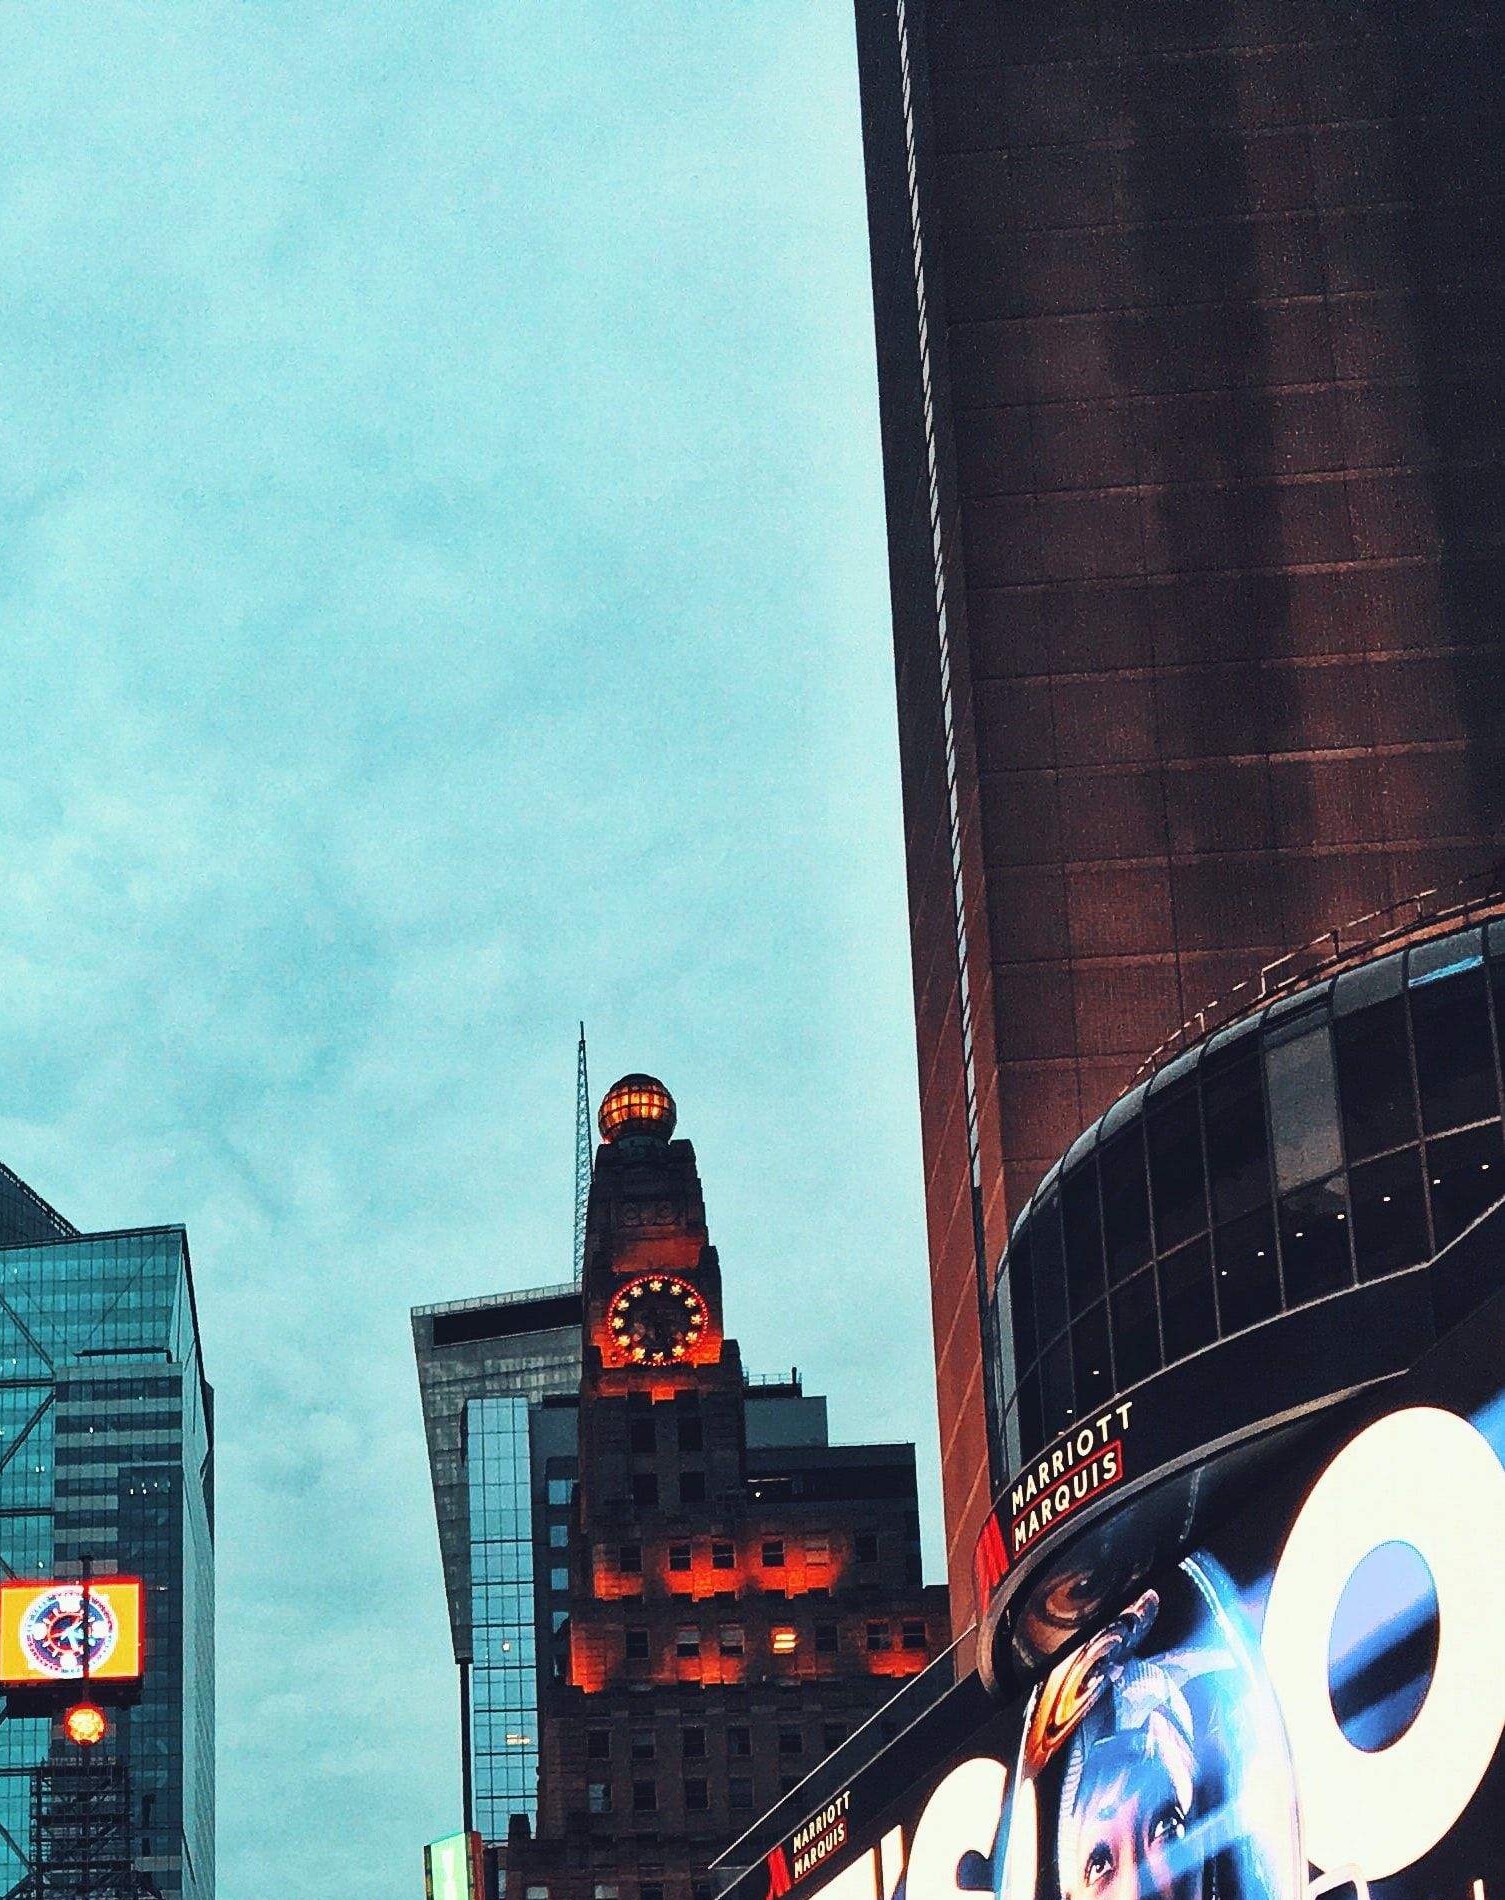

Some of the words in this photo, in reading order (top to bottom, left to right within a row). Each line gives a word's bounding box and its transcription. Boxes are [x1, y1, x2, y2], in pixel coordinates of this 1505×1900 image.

[1011, 1401, 1133, 1516] MARRIOTT
[1013, 1452, 1118, 1551] MARQUIS
[793, 1791, 851, 1854] MARRIOTT
[795, 1823, 845, 1879] MARQUIS
